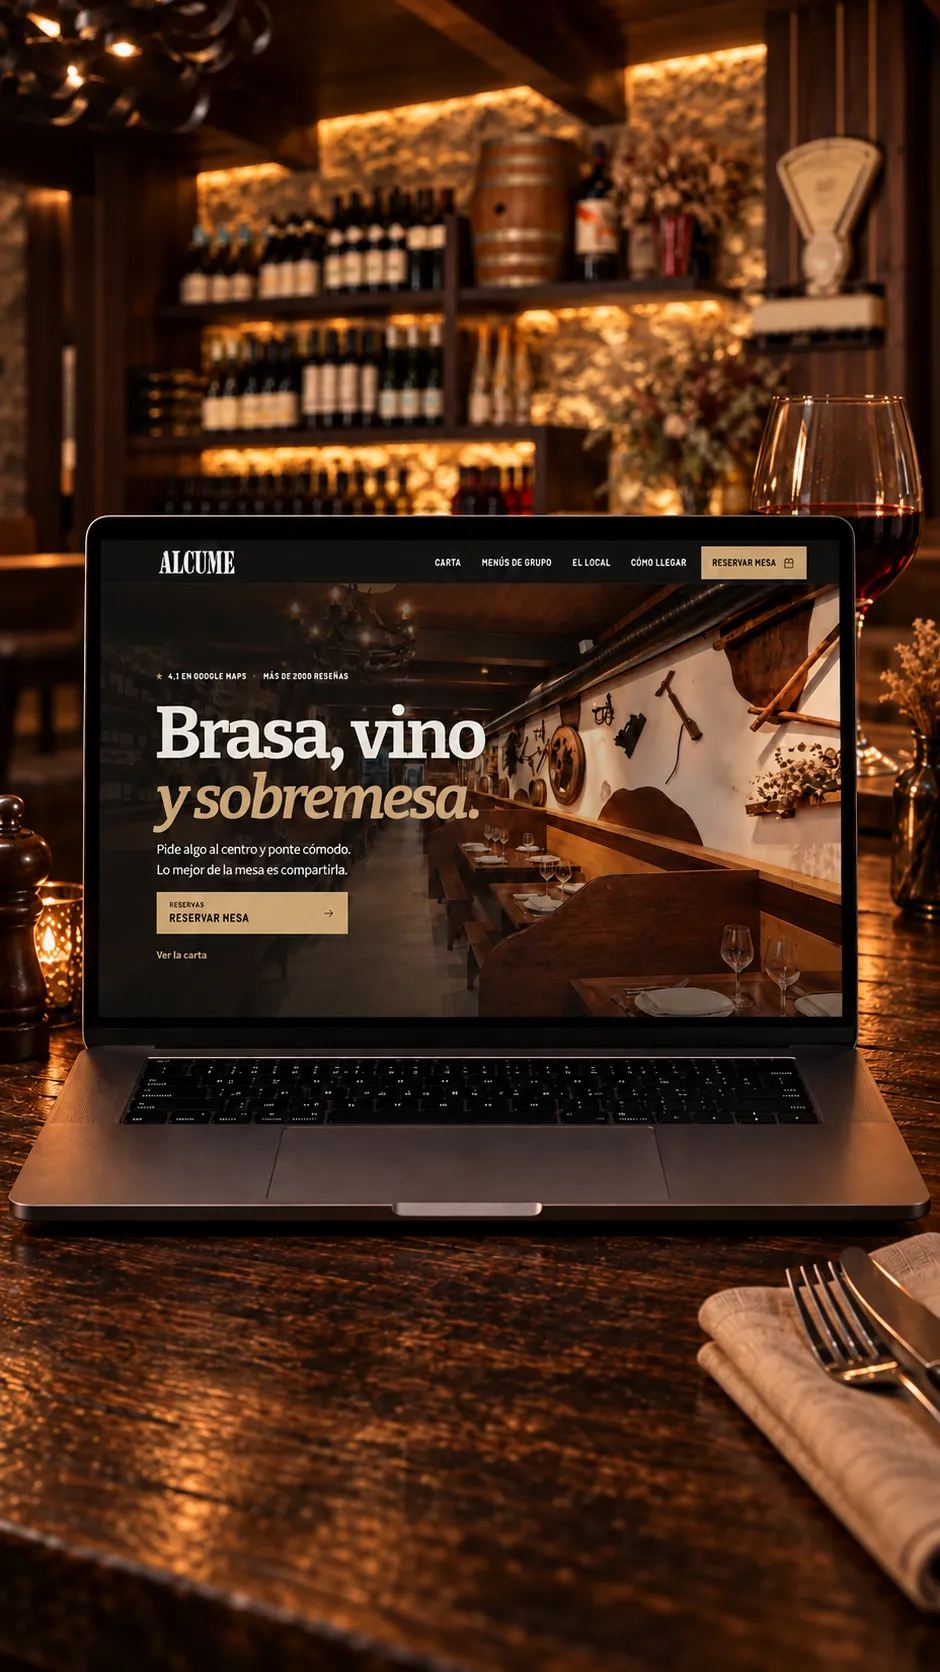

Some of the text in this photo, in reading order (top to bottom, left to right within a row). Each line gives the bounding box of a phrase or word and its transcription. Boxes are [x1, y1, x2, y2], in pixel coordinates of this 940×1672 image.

[158, 549, 236, 576] ALCUME
[434, 558, 462, 567] CARTA
[481, 556, 552, 567] MENÚS DE GRUPO
[572, 558, 611, 567] EL LOCAL
[630, 556, 687, 567] CÓMO LLEGAR
[712, 558, 753, 567] RESERVAR
[181, 672, 192, 681] EN
[262, 670, 349, 681] MÁS DE 2000 RESEÑAS
[156, 703, 486, 771] Brasa, vino
[153, 771, 480, 833] y sobremesa.
[156, 843, 351, 858] Pide algo al centro y ponte cómodo.
[156, 863, 348, 879] Lo mejor de la mesa es compartirla.
[169, 901, 205, 909] RESERVAS
[169, 913, 220, 923] RESERVAR
[156, 950, 208, 960] Ver la carta
